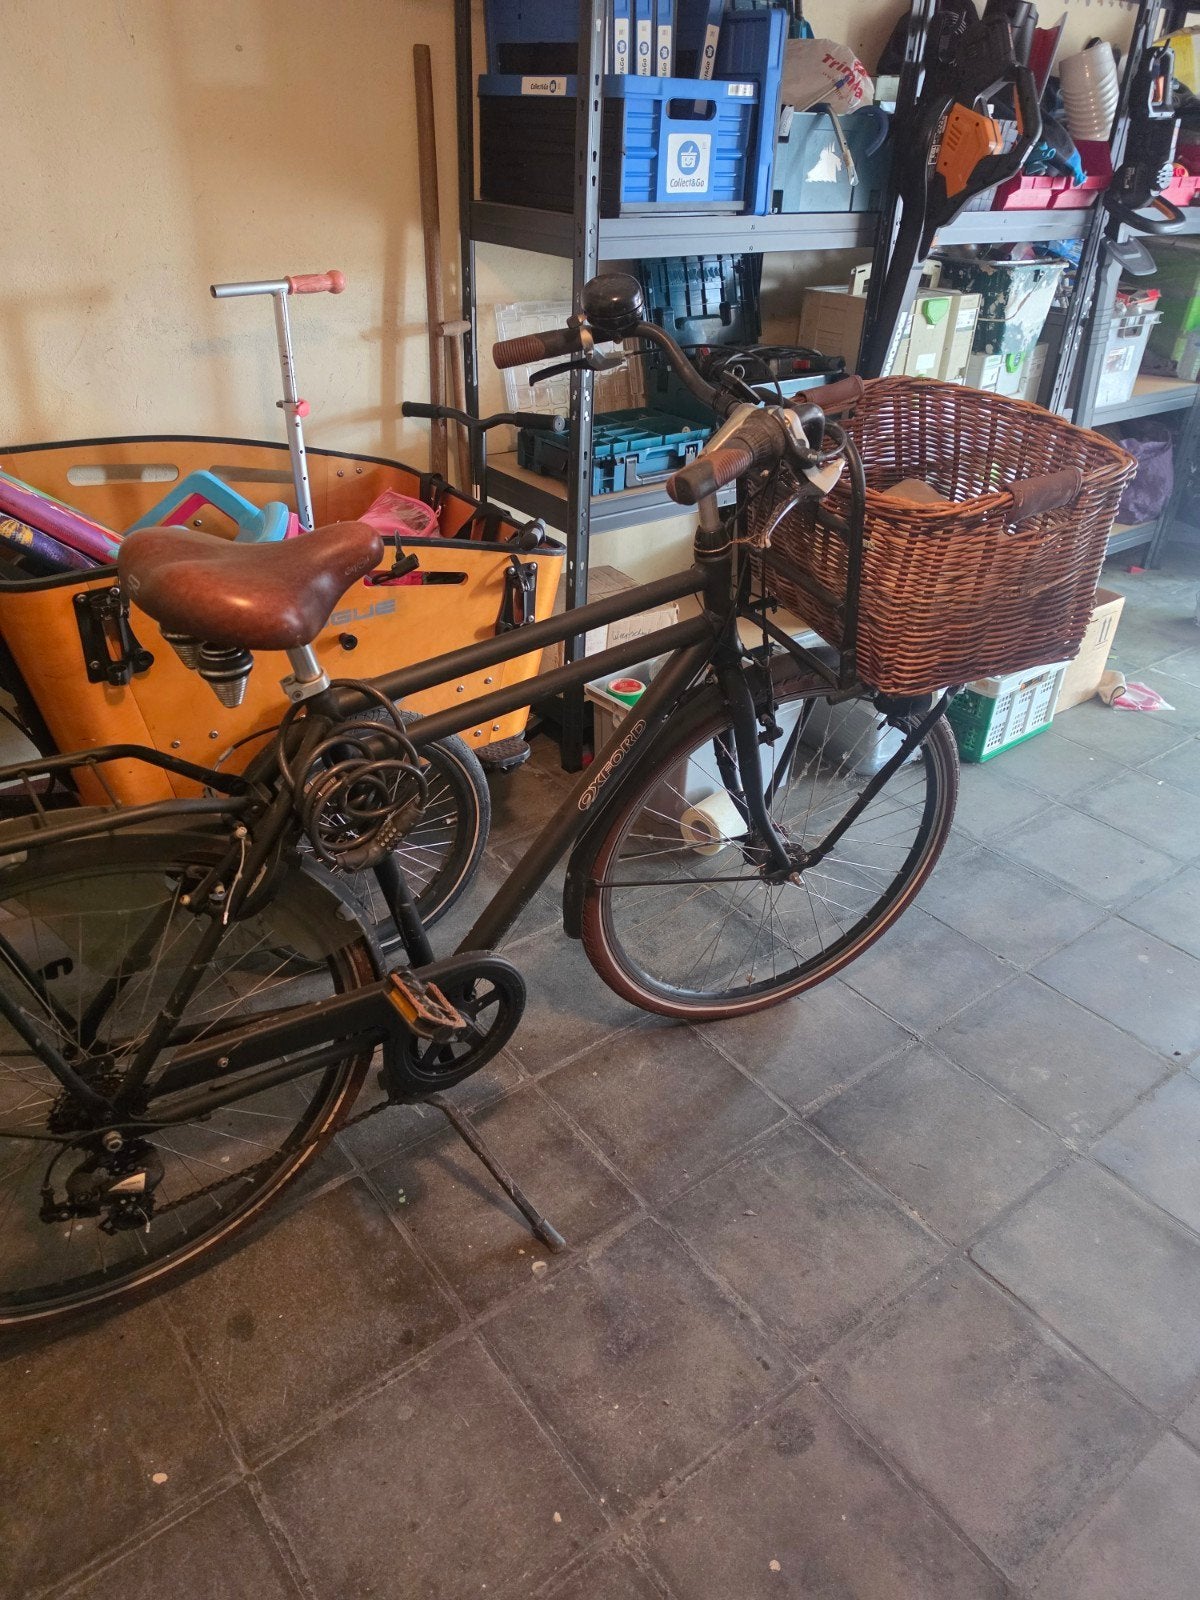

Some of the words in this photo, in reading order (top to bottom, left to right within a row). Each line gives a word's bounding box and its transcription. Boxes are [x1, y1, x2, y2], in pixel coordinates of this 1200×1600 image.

[669, 177, 705, 188] Collect&Go
[325, 598, 397, 627] GUE
[577, 719, 647, 811] OXFORD
